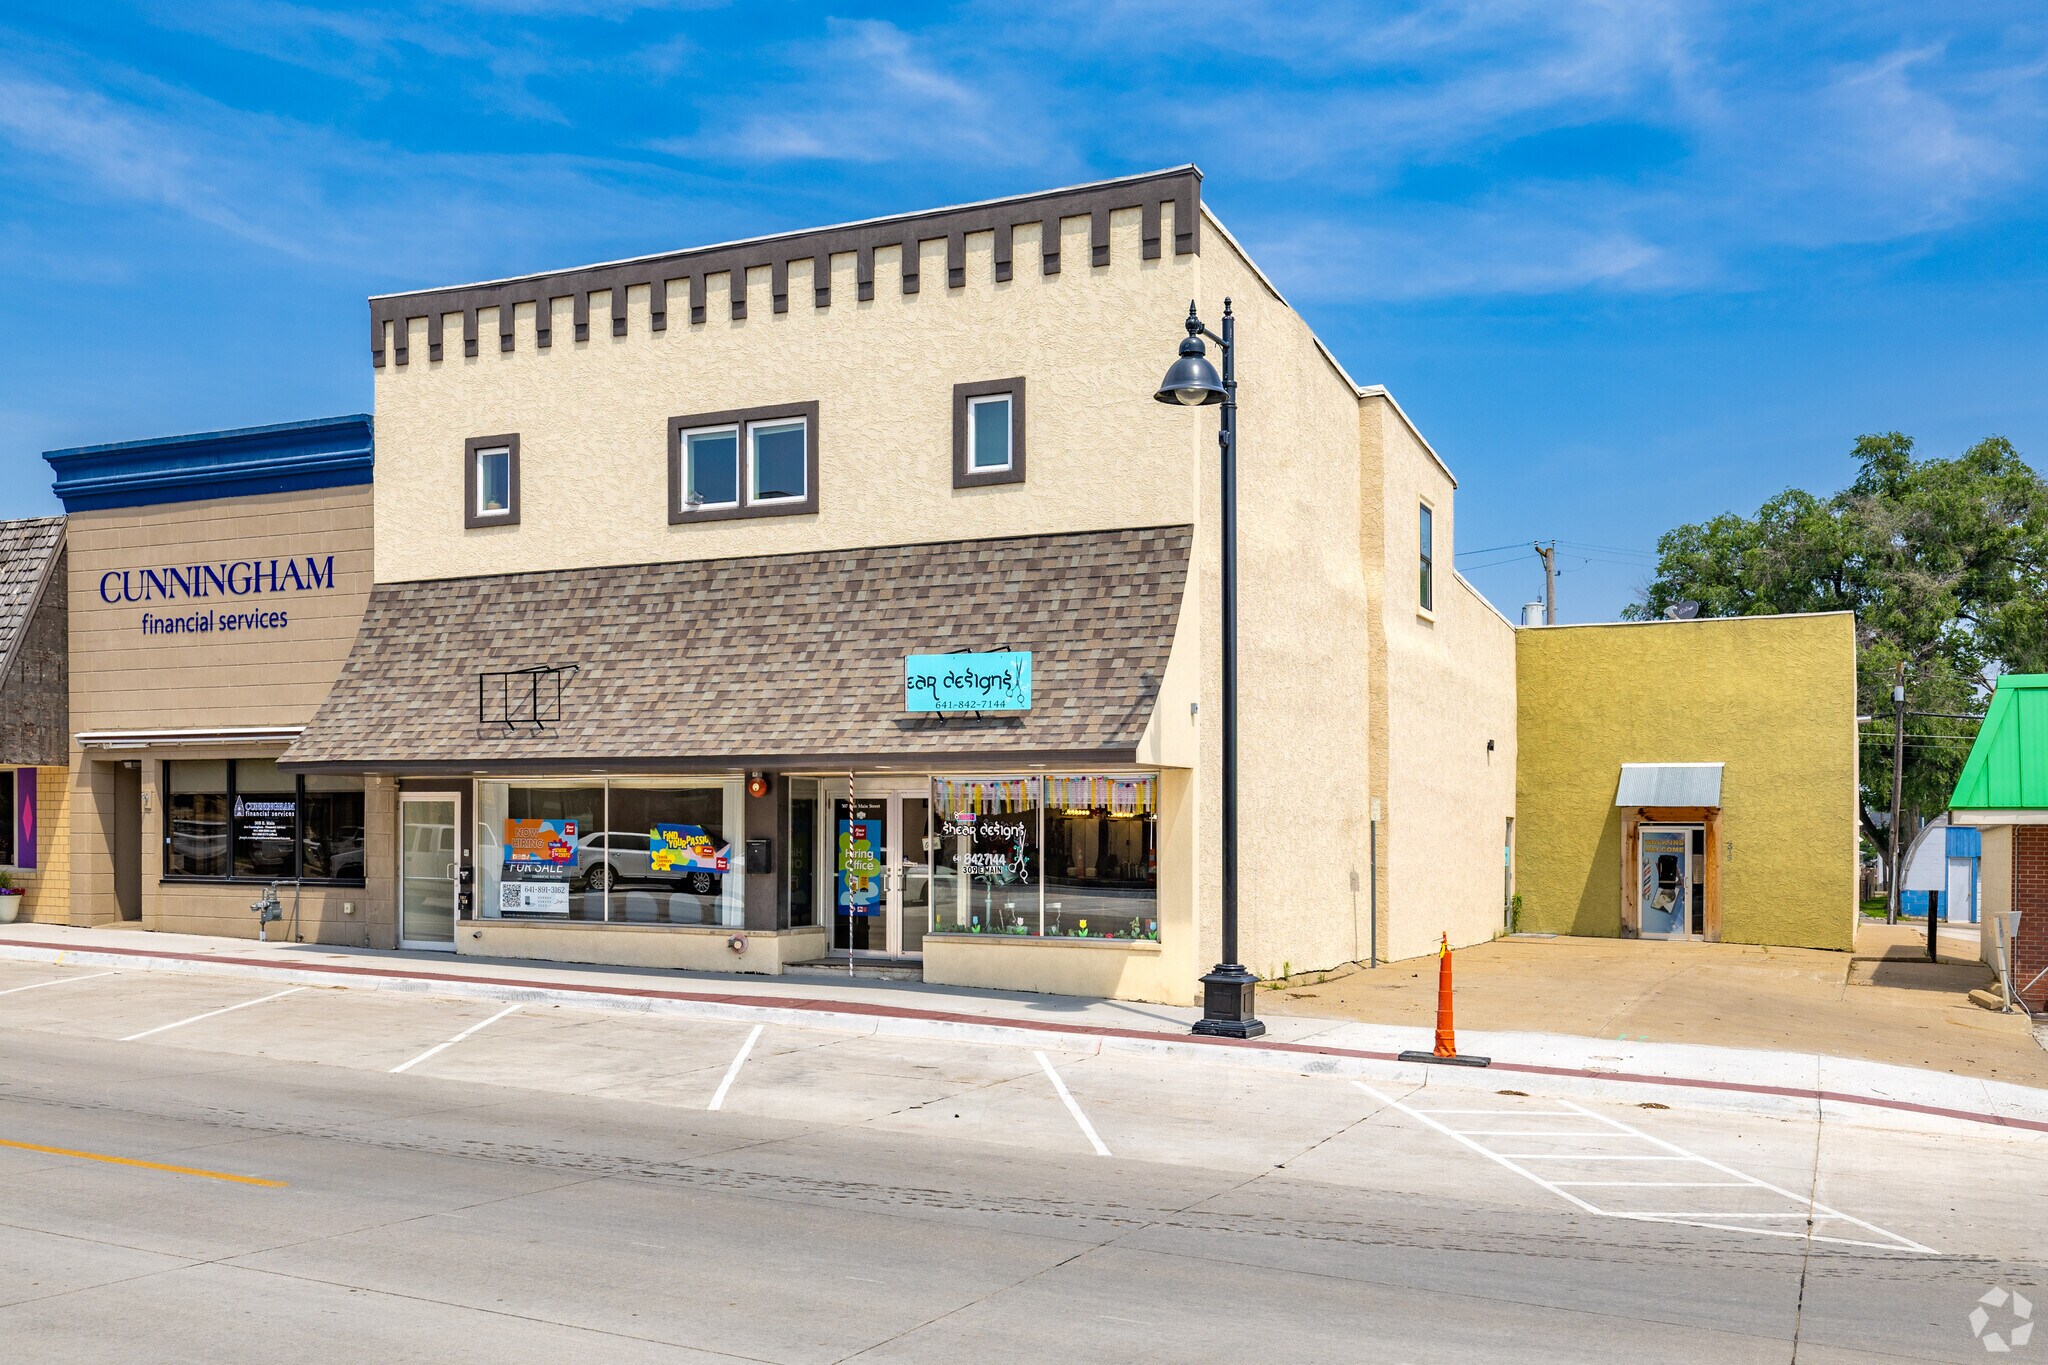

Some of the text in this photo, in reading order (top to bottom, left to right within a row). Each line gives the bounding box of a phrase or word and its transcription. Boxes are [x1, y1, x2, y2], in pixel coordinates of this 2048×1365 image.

[100, 556, 334, 603] CUNNINGHAM
[142, 608, 288, 635] financial services
[936, 700, 1006, 709] 641-842-7144
[515, 828, 539, 838] NOW
[663, 831, 678, 841] FIND
[512, 838, 544, 848] HIRING
[669, 838, 686, 848] YOUR
[845, 849, 874, 860] Hring
[510, 864, 563, 873] FOR SALE
